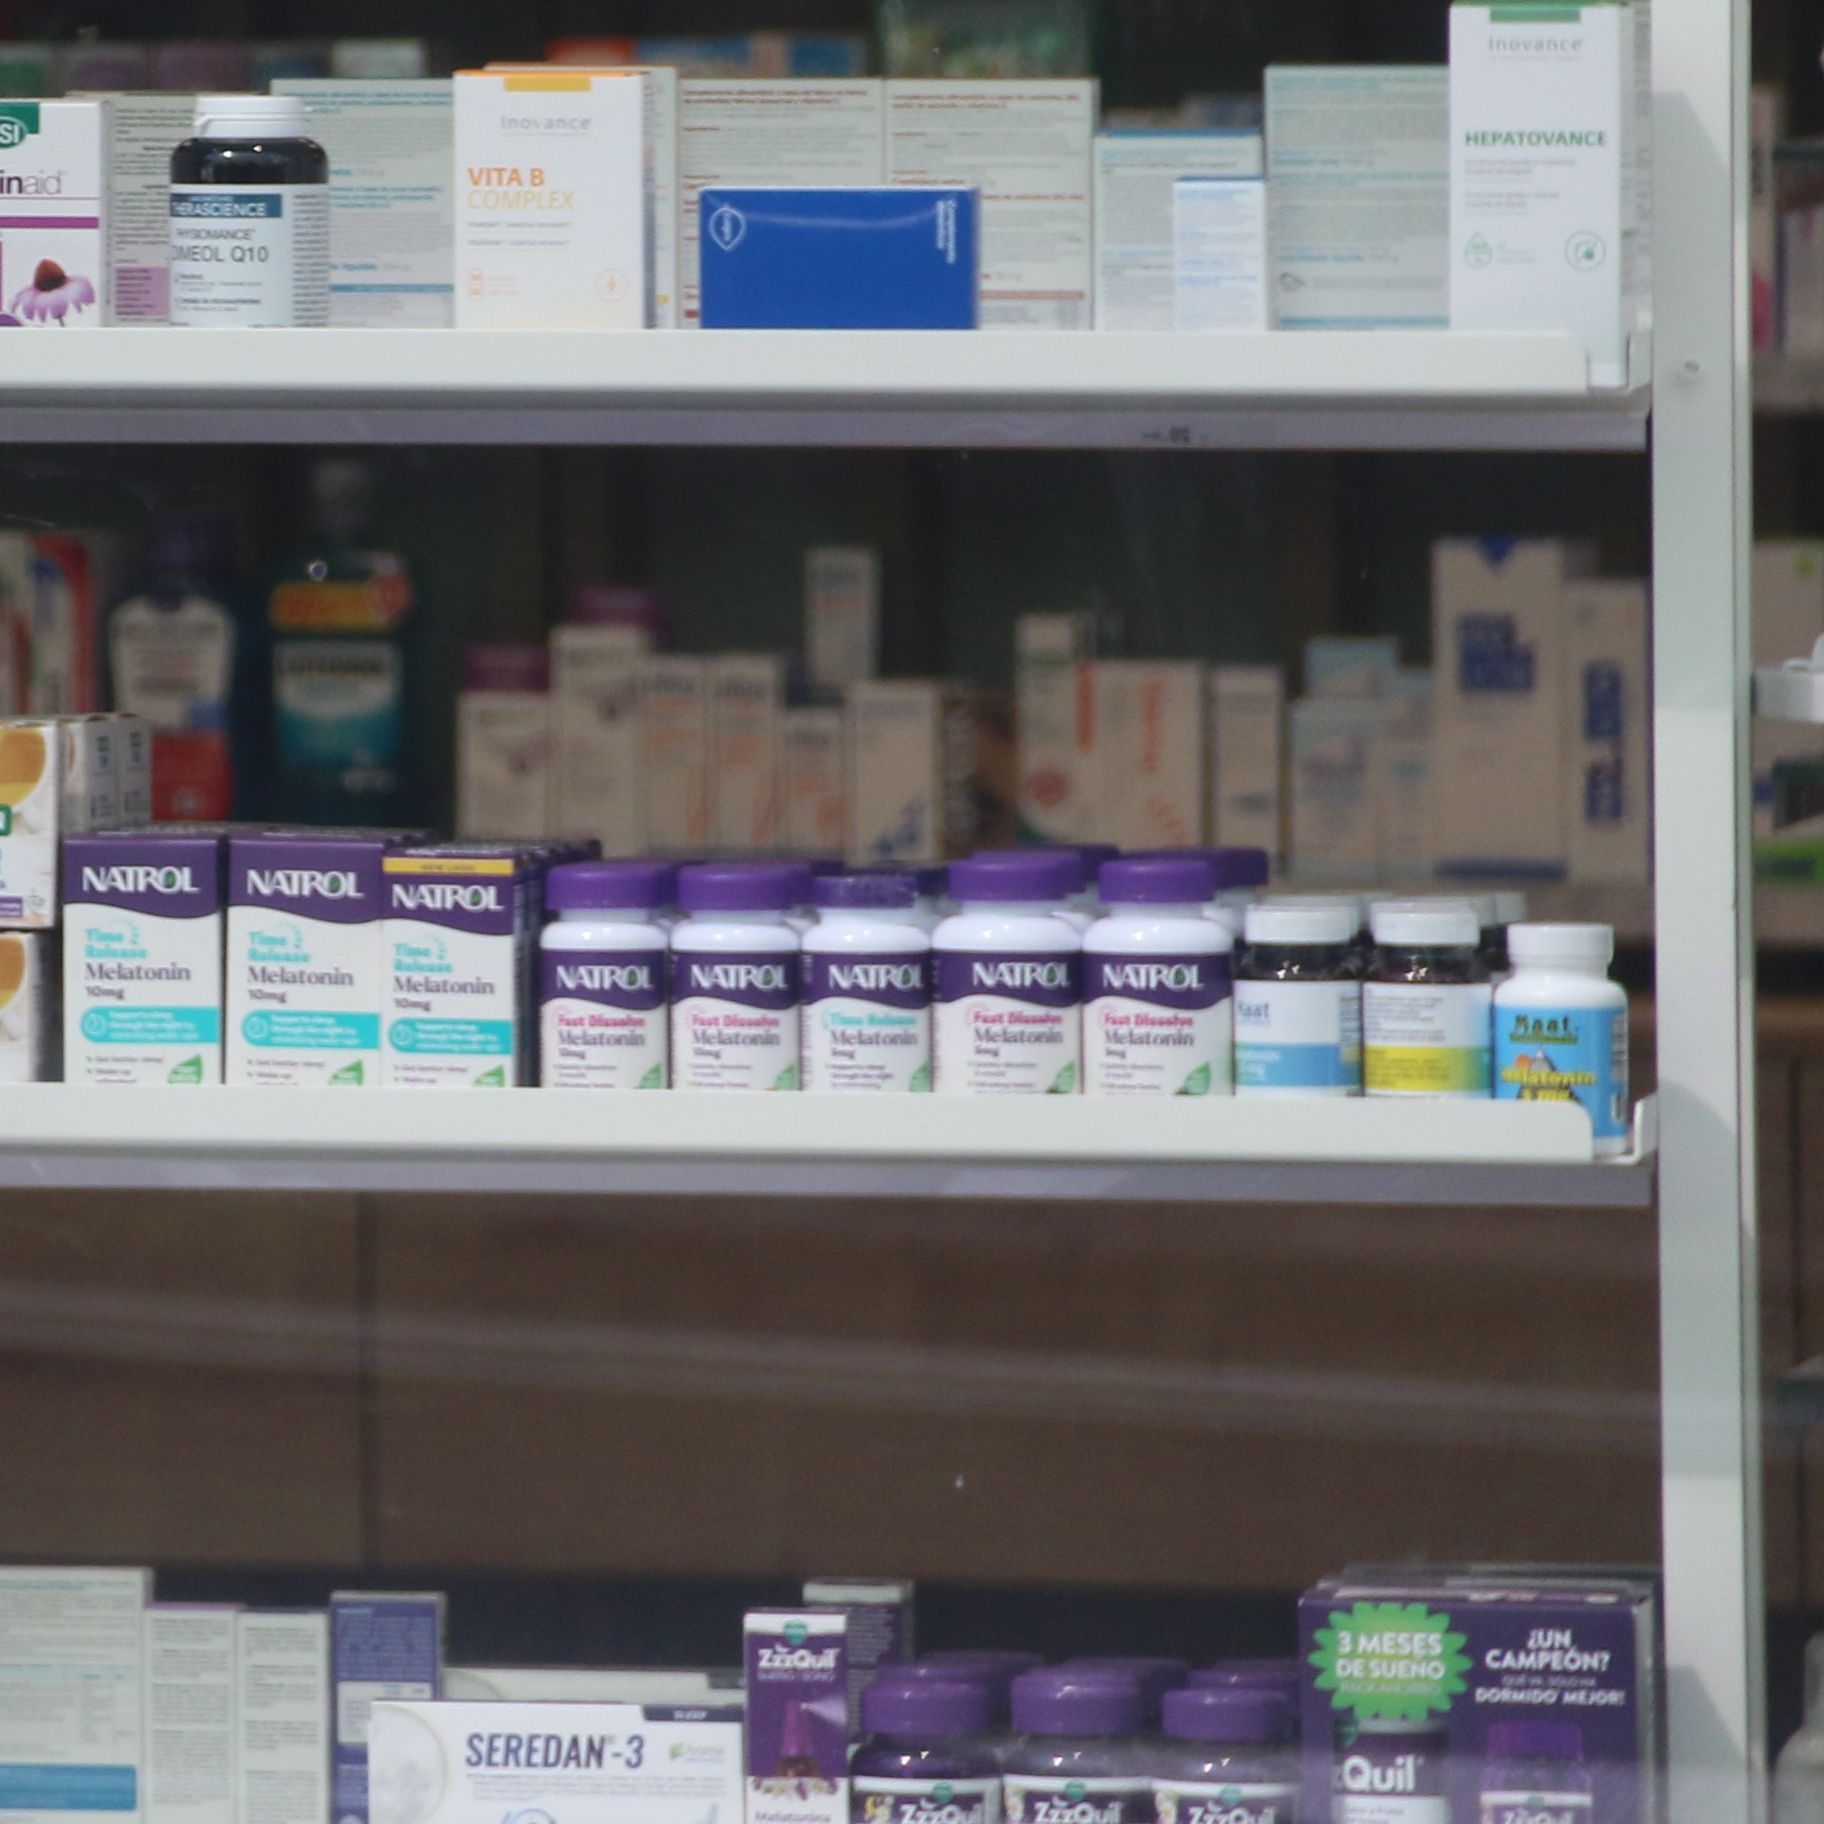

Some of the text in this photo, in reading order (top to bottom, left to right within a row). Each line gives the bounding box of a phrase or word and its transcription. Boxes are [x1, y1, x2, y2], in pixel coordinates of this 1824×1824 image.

[1464, 130, 1607, 148] HEPATOVANCE
[467, 167, 546, 188] VITA B
[467, 189, 575, 211] COMPLEX
[231, 245, 269, 264] Q10
[82, 866, 200, 893] NATROL
[247, 869, 364, 898] NATROL
[392, 884, 504, 912] NATROL
[85, 962, 192, 982] Melatonin
[247, 967, 354, 986] Melatonin
[557, 964, 654, 990] NATROL
[691, 964, 789, 990] NATROL
[828, 964, 923, 989] NATROL
[558, 1029, 646, 1048] Melatonin
[1104, 1029, 1195, 1047] Melatonin
[1337, 1632, 1443, 1656] 3 MESES
[1336, 1659, 1365, 1677] DE
[1485, 1648, 1611, 1672] CAMPEÓN?
[1475, 1688, 1559, 1704] DORMIDO
